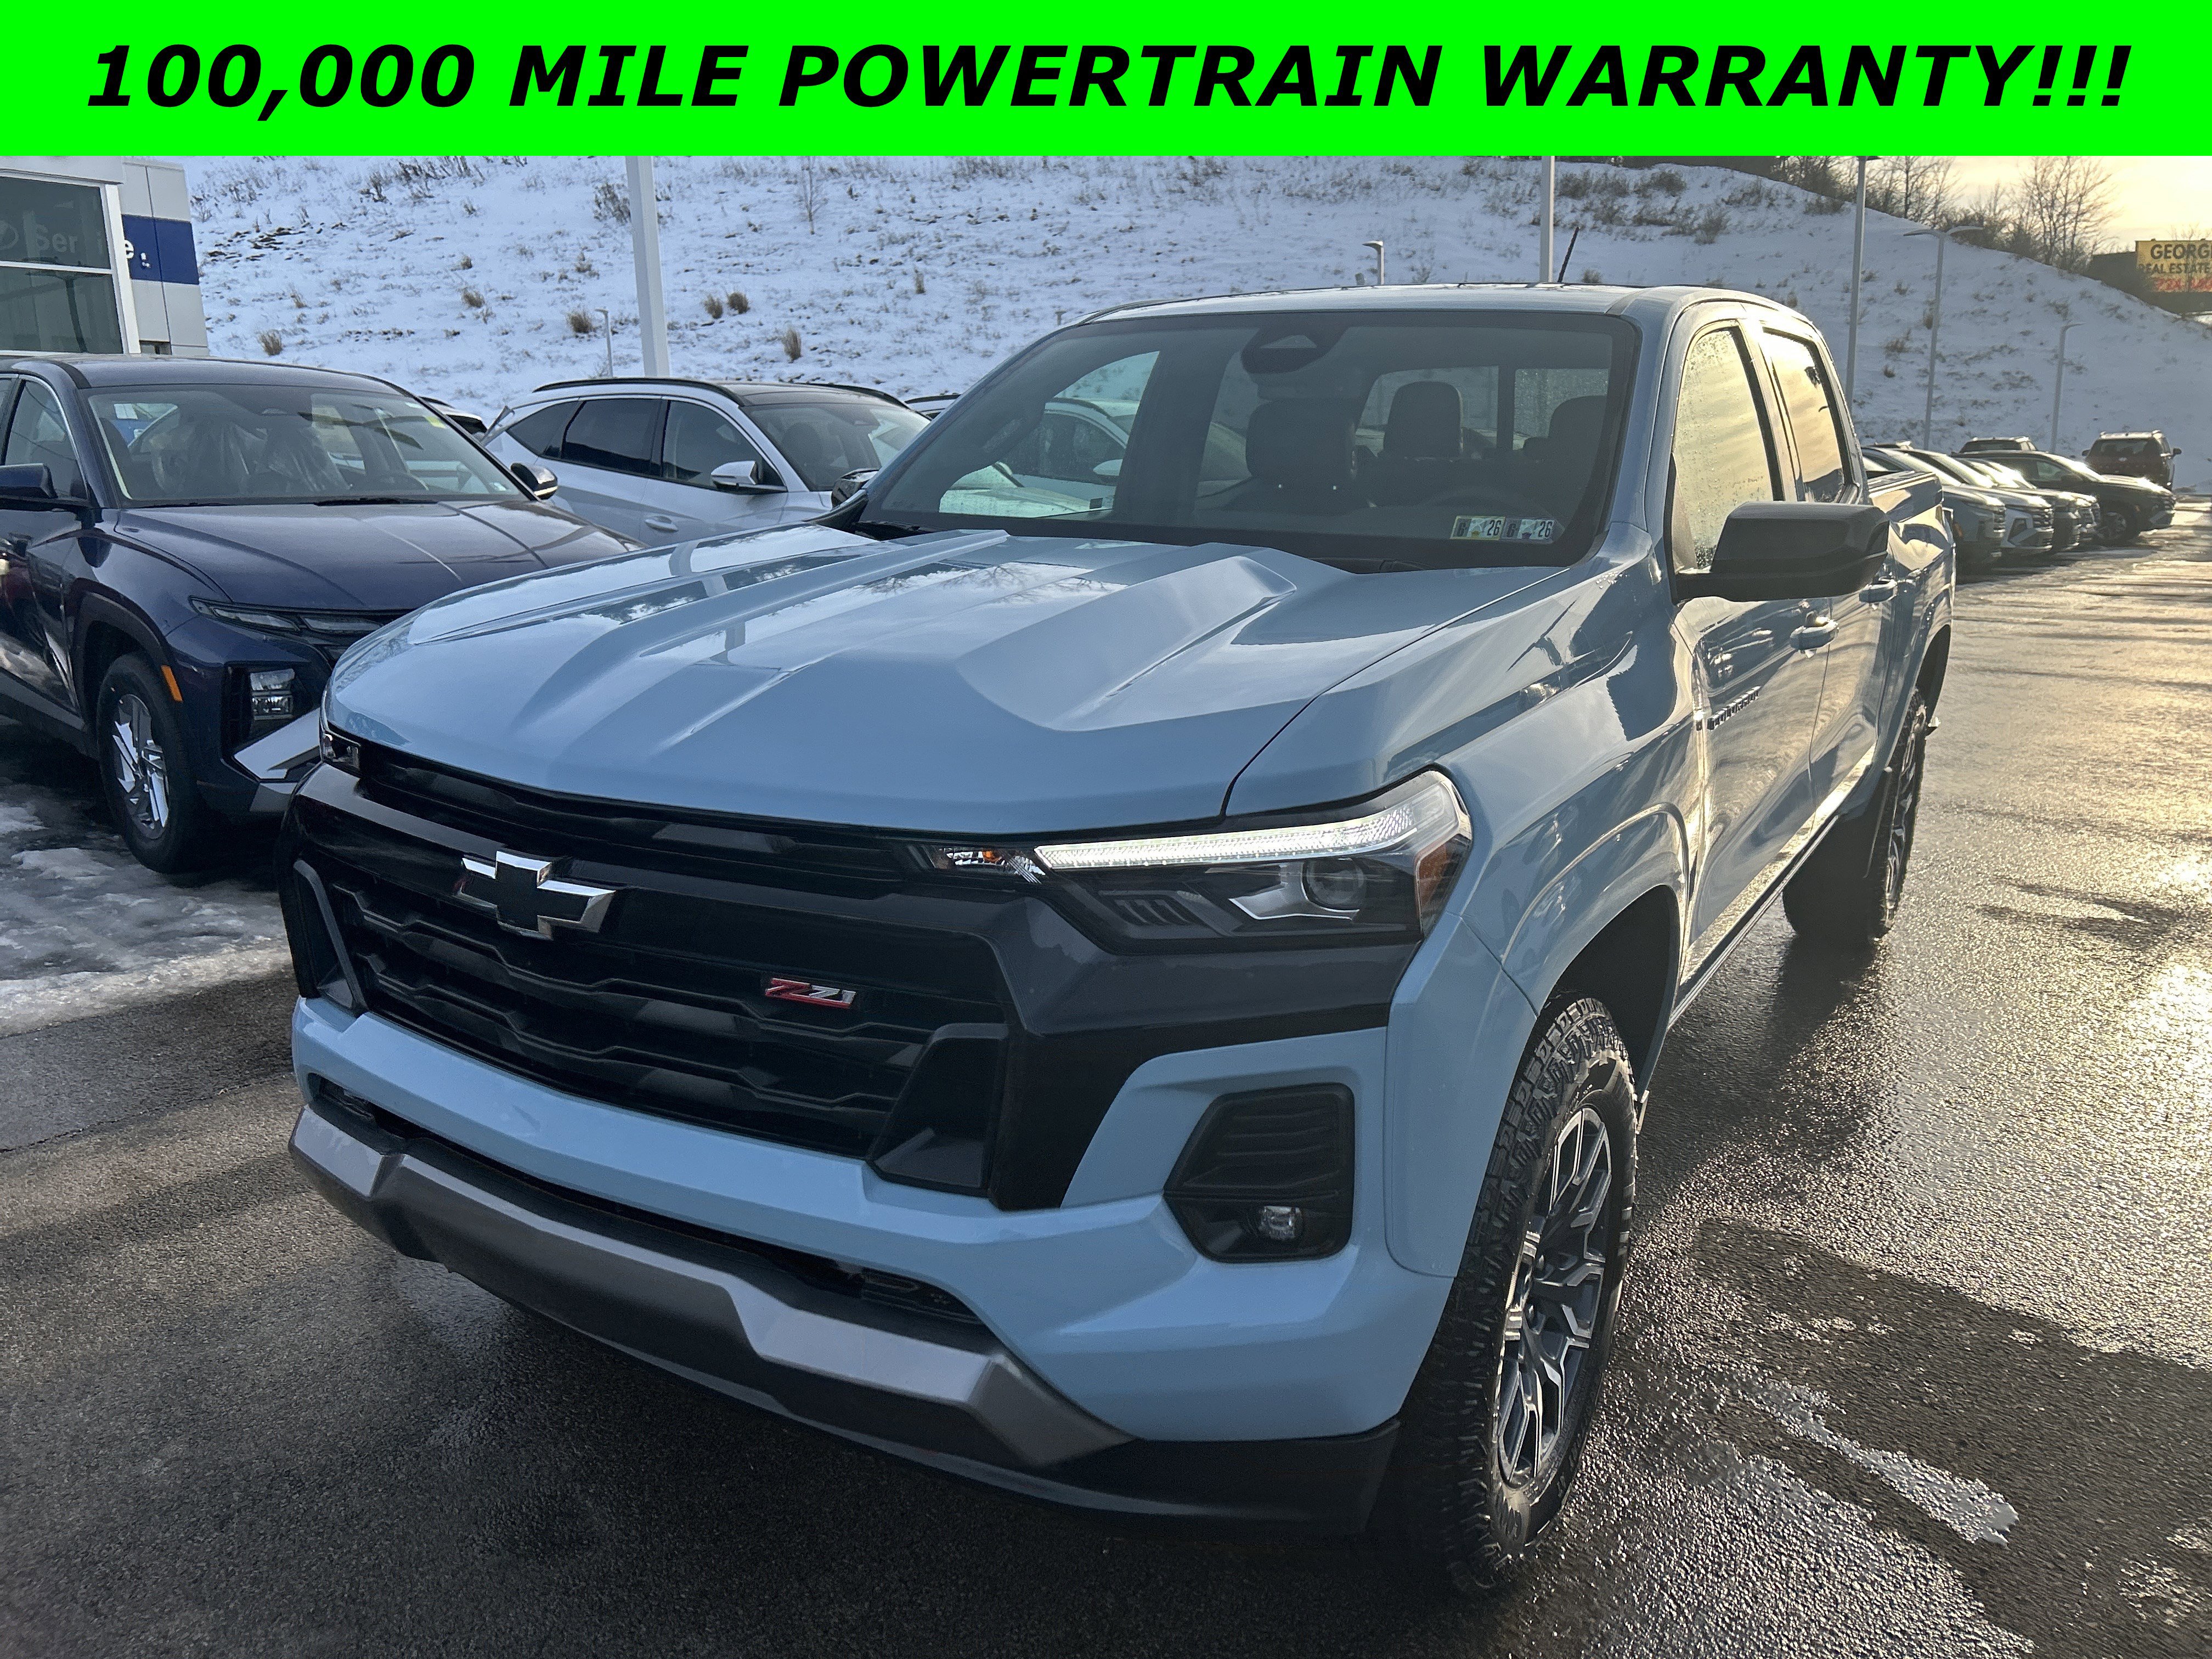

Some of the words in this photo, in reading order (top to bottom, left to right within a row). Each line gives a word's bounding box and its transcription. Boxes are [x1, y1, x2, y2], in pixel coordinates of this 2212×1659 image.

[2150, 243, 2212, 259] GEORG
[2169, 262, 2211, 274] ESTATE
[1486, 519, 1502, 537] 26
[1538, 521, 1553, 538] 26
[765, 978, 857, 1009] Z71
